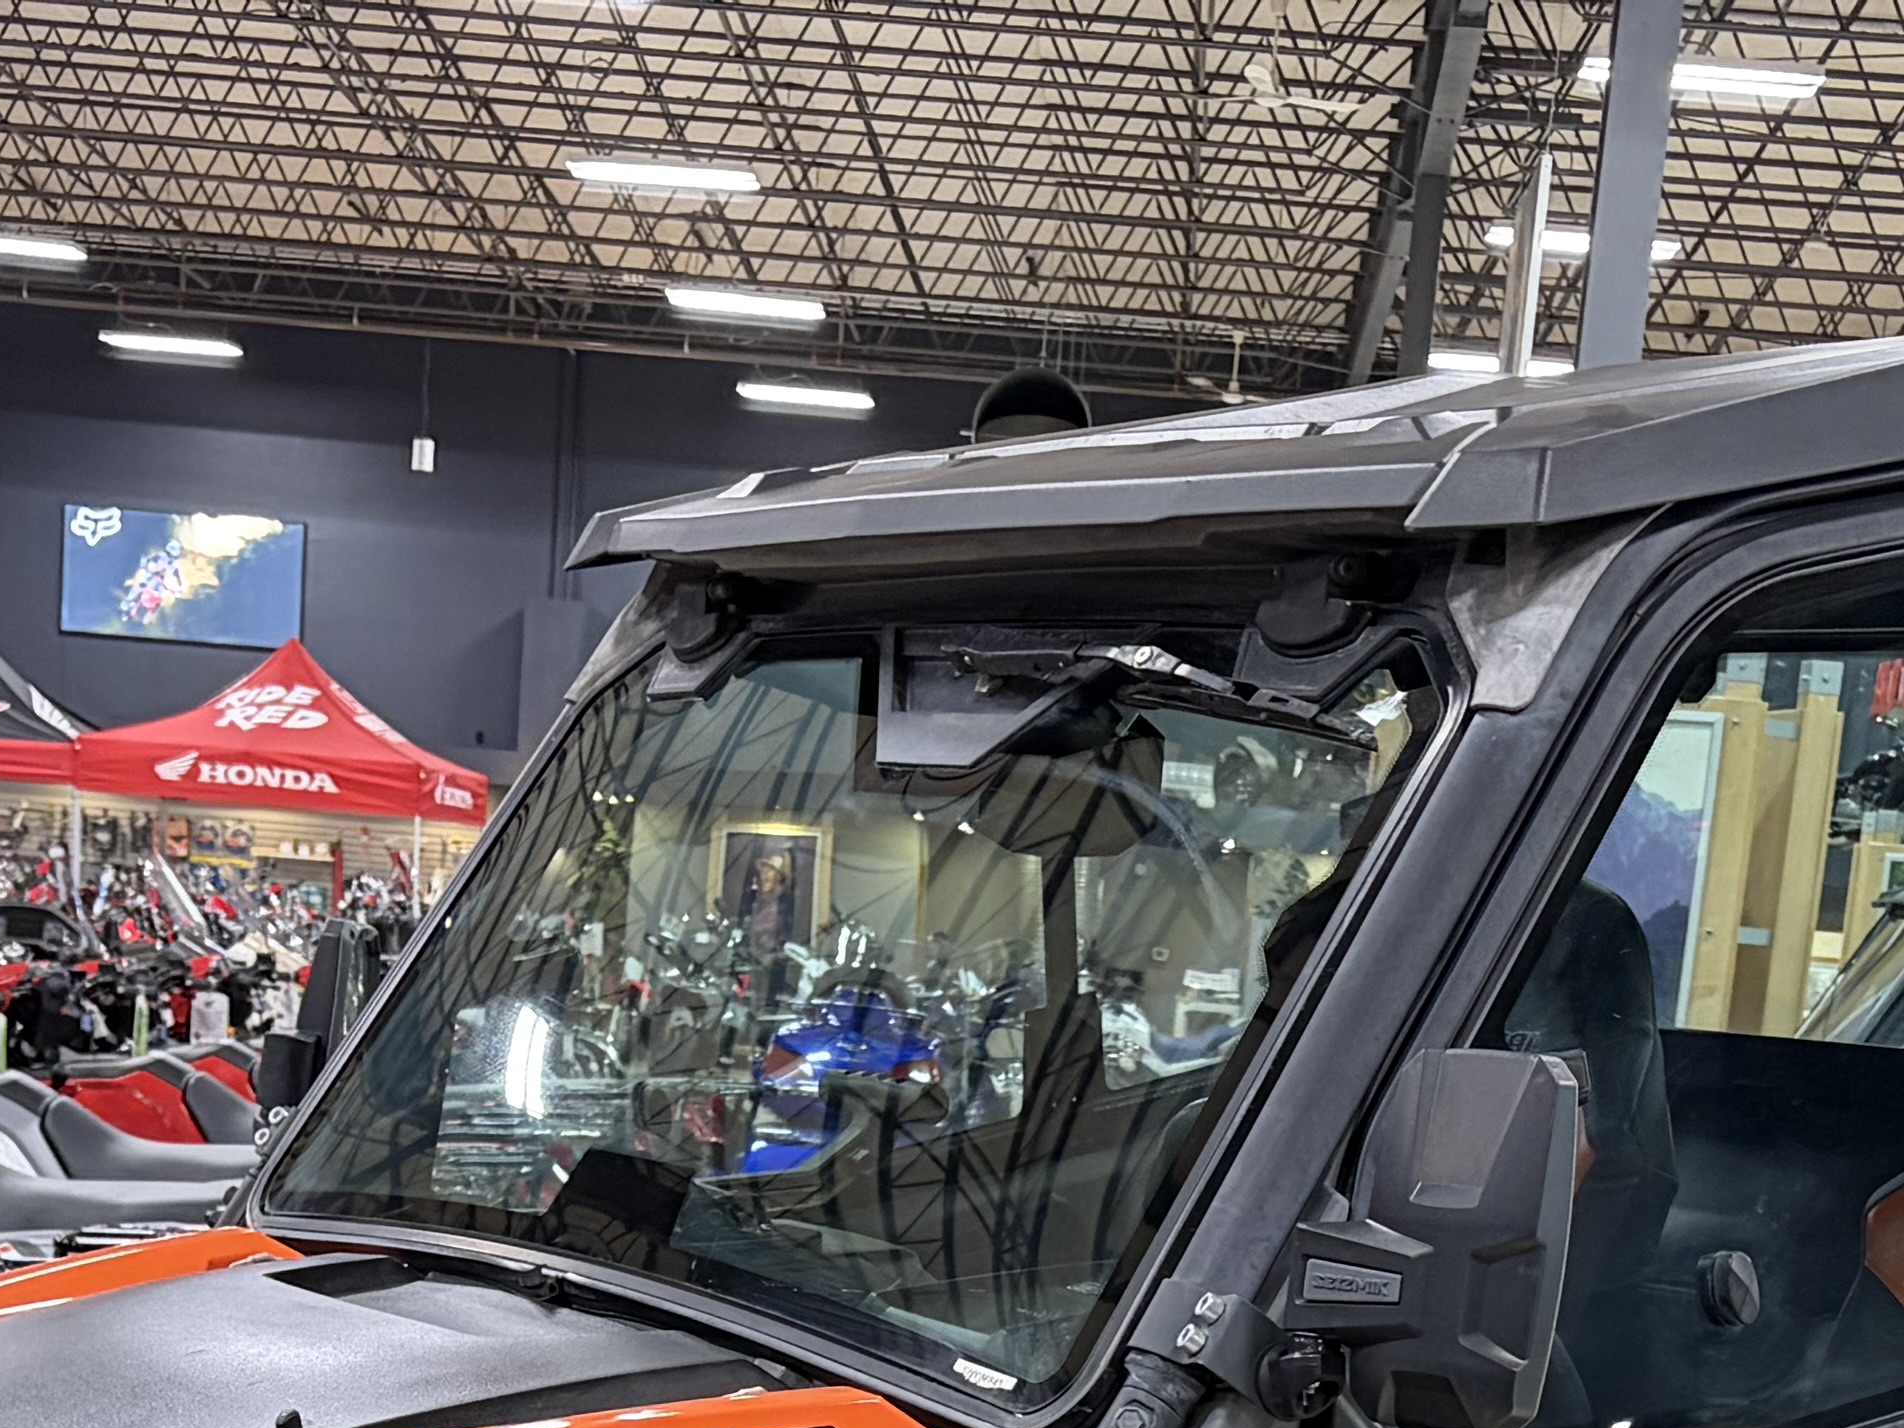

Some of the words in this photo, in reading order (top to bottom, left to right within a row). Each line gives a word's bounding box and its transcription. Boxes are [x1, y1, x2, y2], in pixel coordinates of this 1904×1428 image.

[214, 685, 322, 710] RIDE
[214, 705, 330, 731] RED
[197, 762, 341, 794] HONDA
